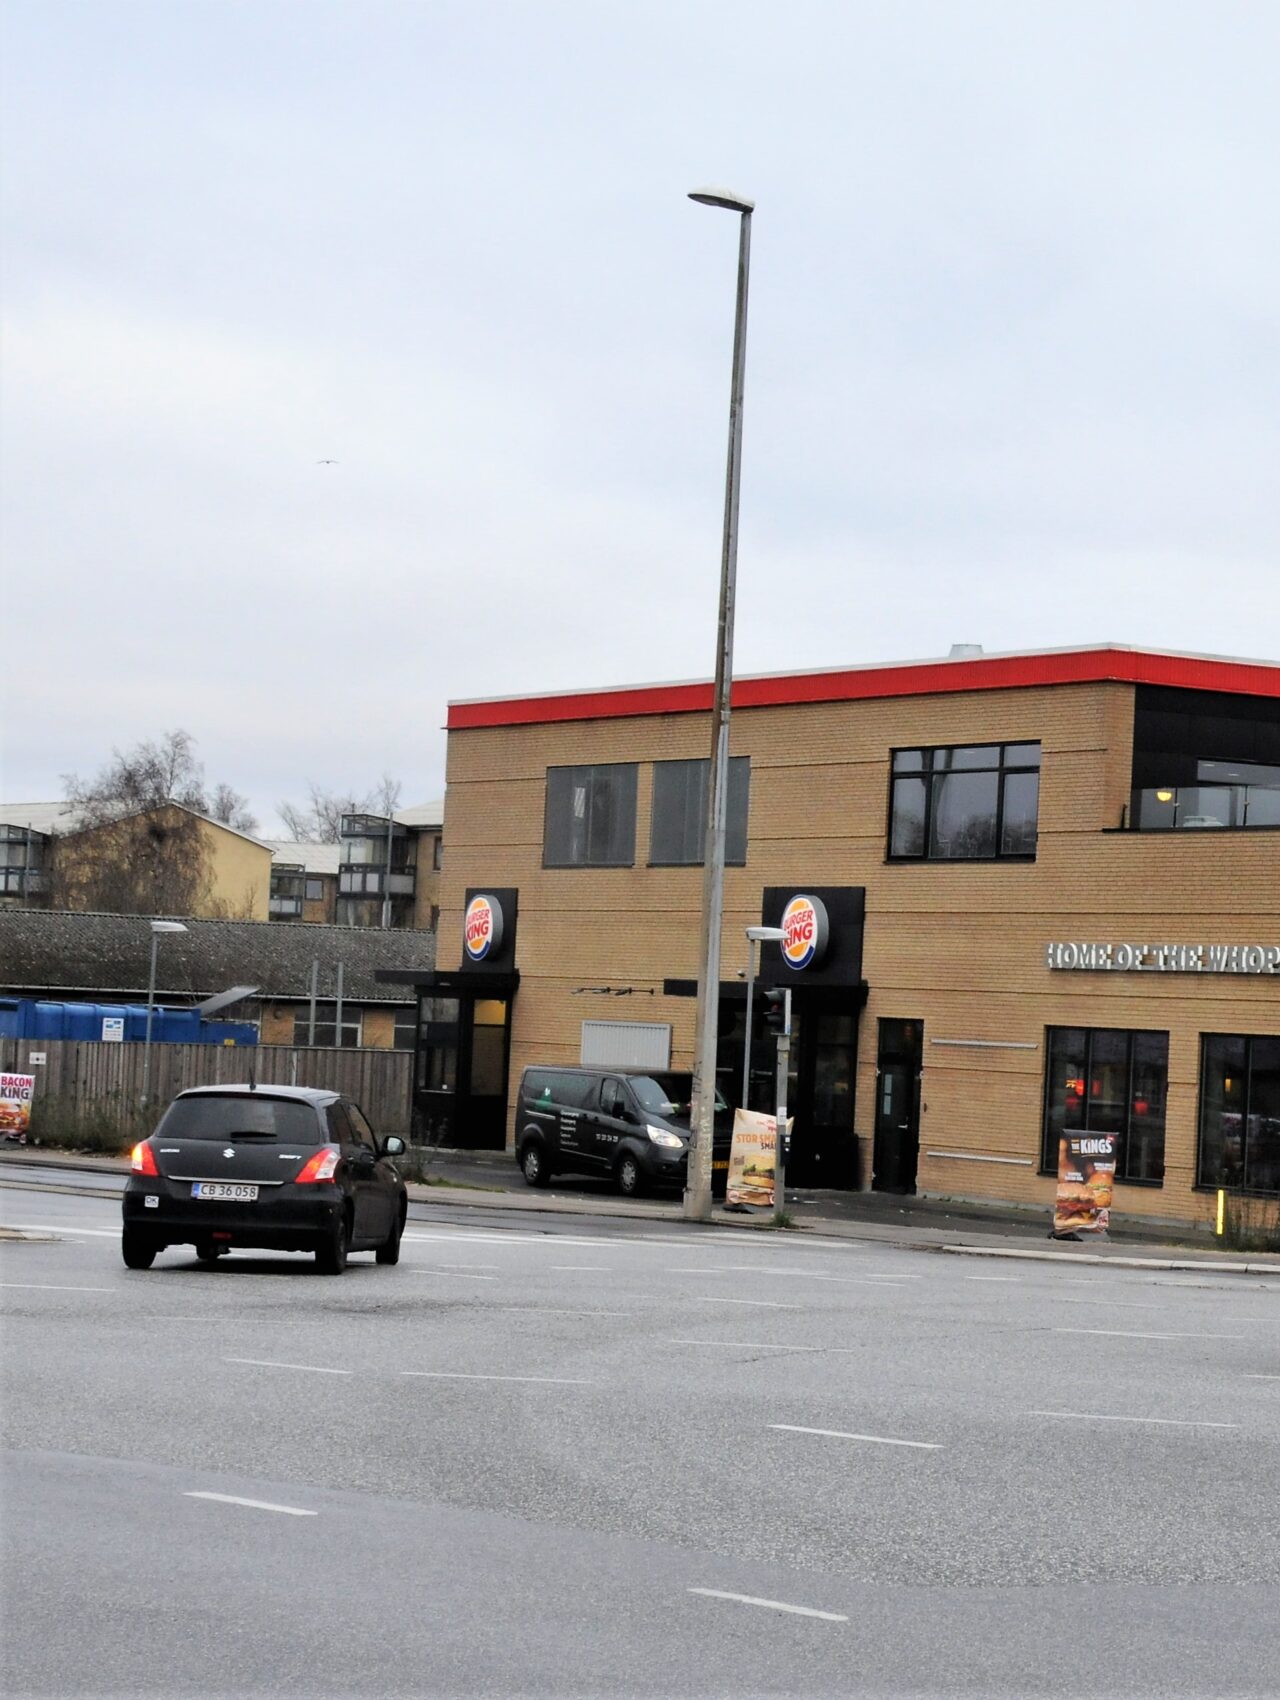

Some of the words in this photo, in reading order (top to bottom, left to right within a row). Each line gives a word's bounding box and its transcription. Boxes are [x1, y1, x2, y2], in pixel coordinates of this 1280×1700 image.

[1046, 942, 1112, 969] HOME
[1114, 943, 1149, 971] OF
[1153, 944, 1204, 972] THE
[1, 1076, 33, 1088] BACON
[0, 1086, 29, 1100] KING
[735, 1133, 758, 1144] STOR
[760, 1134, 777, 1145] SMA
[1080, 1138, 1113, 1154] KINGS
[201, 1184, 217, 1195] CB
[219, 1185, 232, 1196] 36
[235, 1186, 256, 1198] 058
